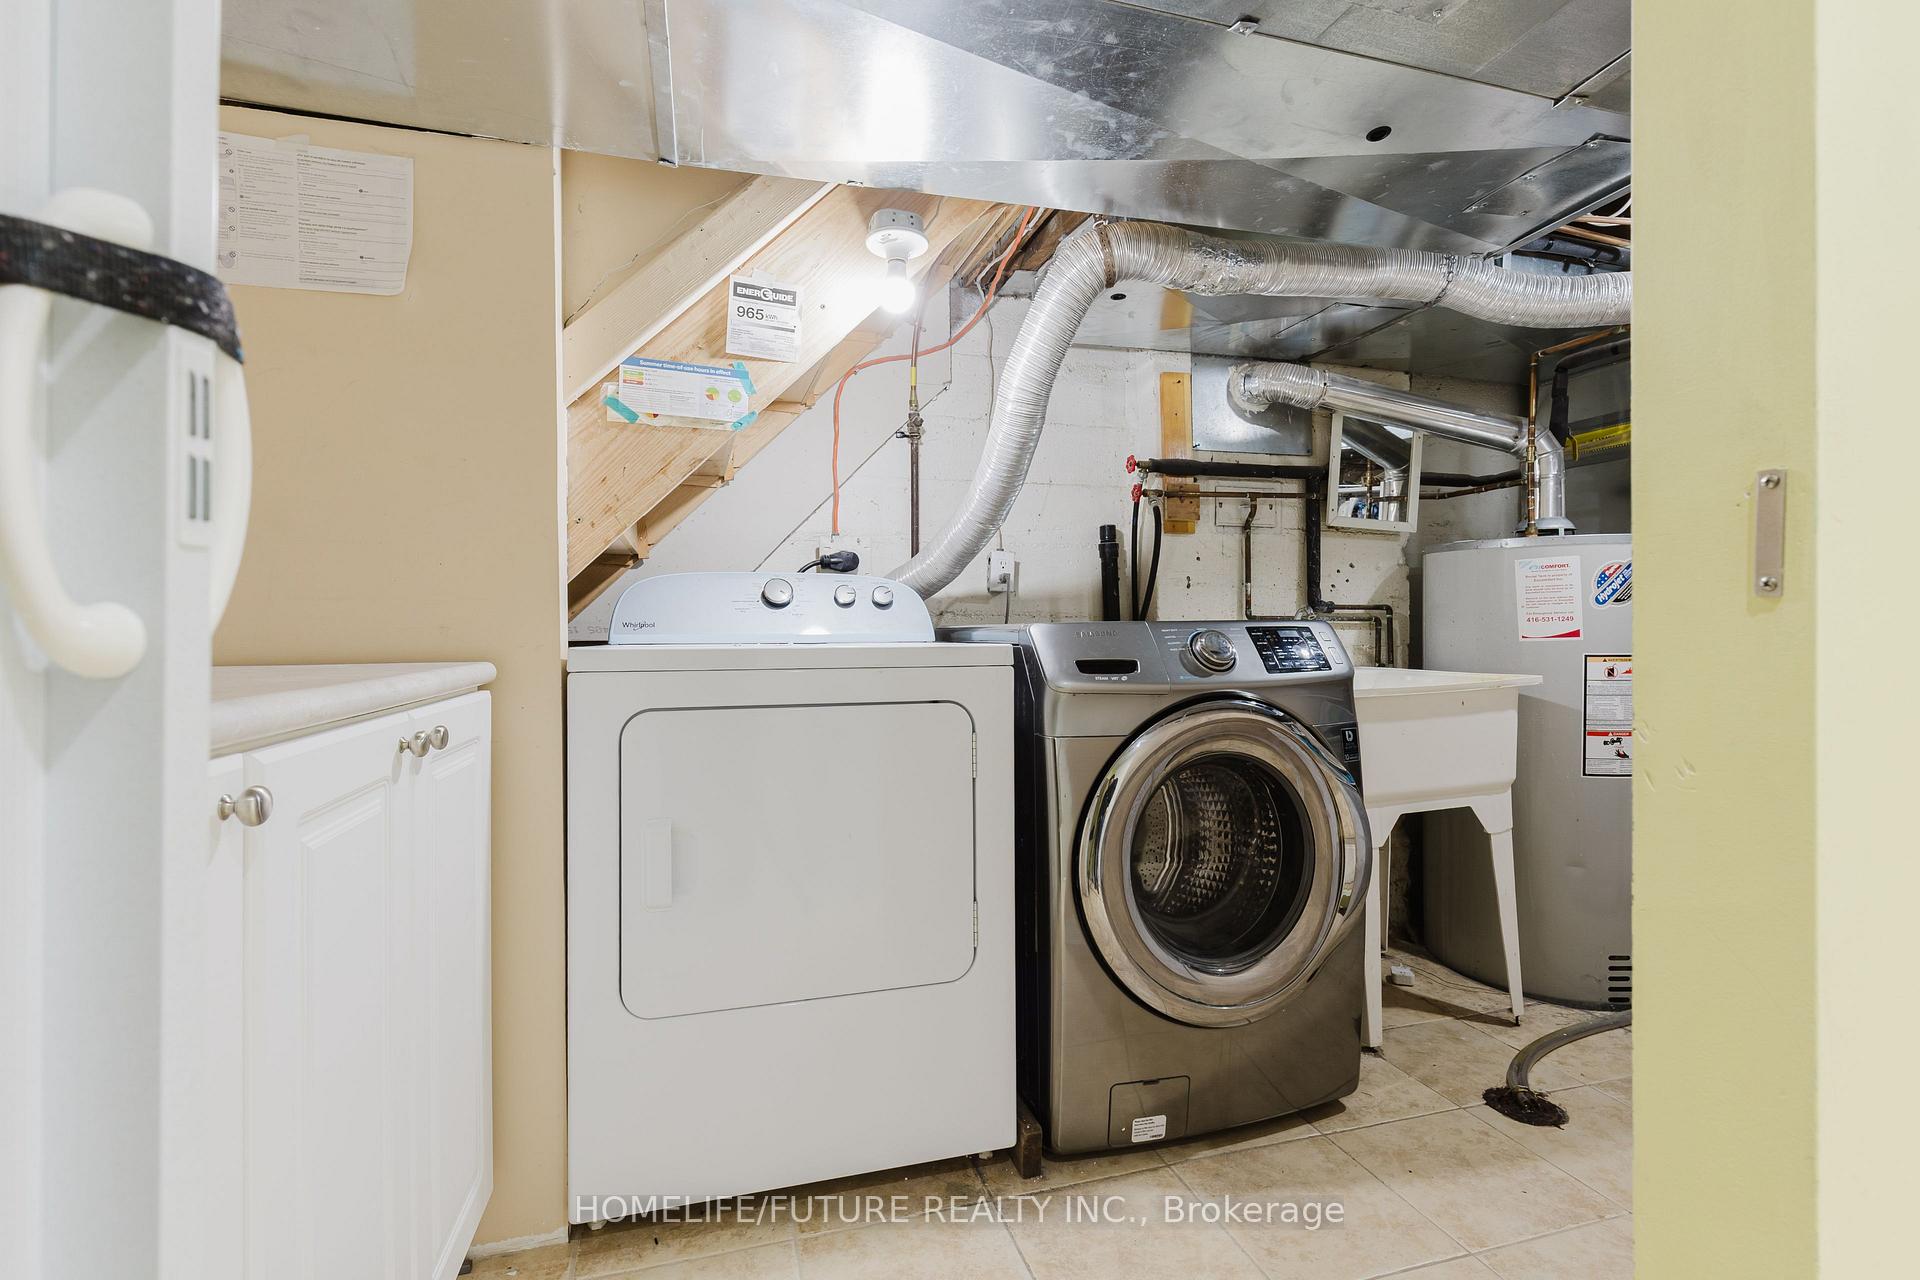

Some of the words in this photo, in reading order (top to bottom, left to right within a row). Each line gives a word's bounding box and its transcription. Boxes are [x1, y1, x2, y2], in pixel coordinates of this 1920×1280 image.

[736, 305, 764, 320] 965
[1597, 574, 1625, 603] Hydrojet
[621, 621, 656, 631] Whirlpool
